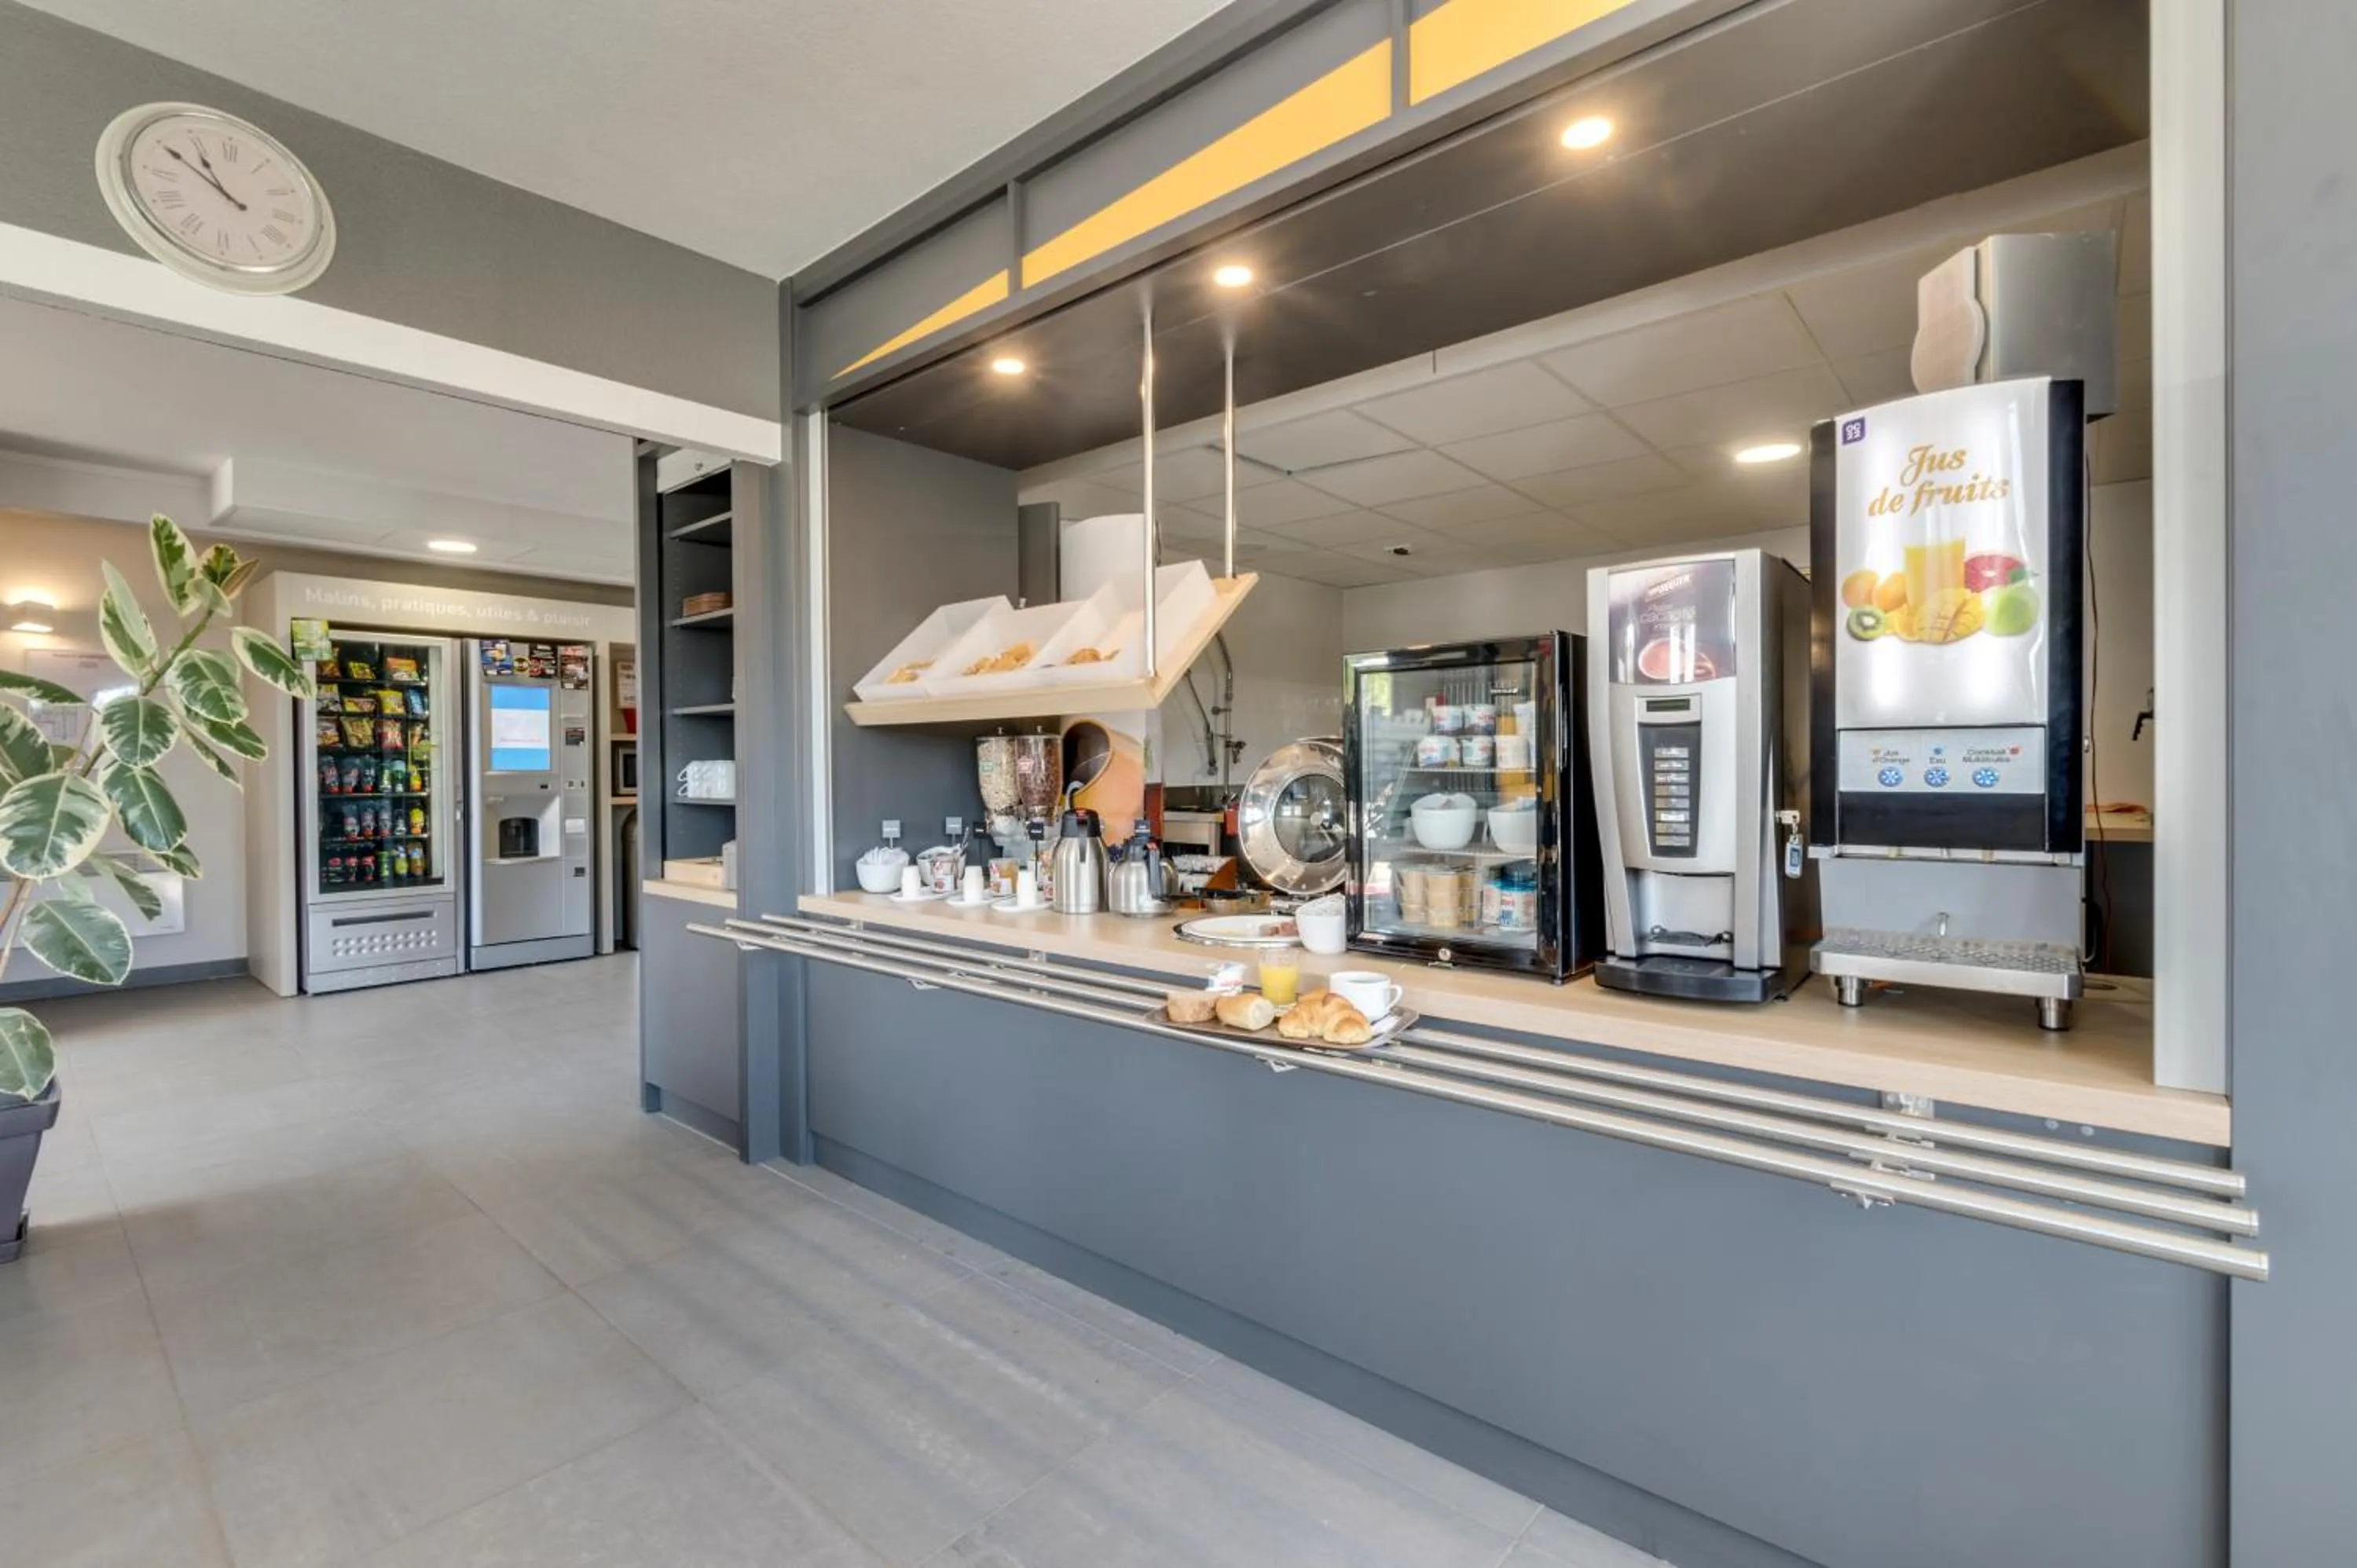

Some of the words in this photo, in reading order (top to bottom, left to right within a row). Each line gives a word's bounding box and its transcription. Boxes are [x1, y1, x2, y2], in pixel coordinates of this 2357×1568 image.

[1899, 444, 1967, 488] Jus
[1867, 486, 1904, 517] de
[1908, 472, 2010, 517] fruits
[305, 587, 377, 611] Malins,
[381, 595, 471, 619] pratiques,
[475, 606, 522, 622] utiles
